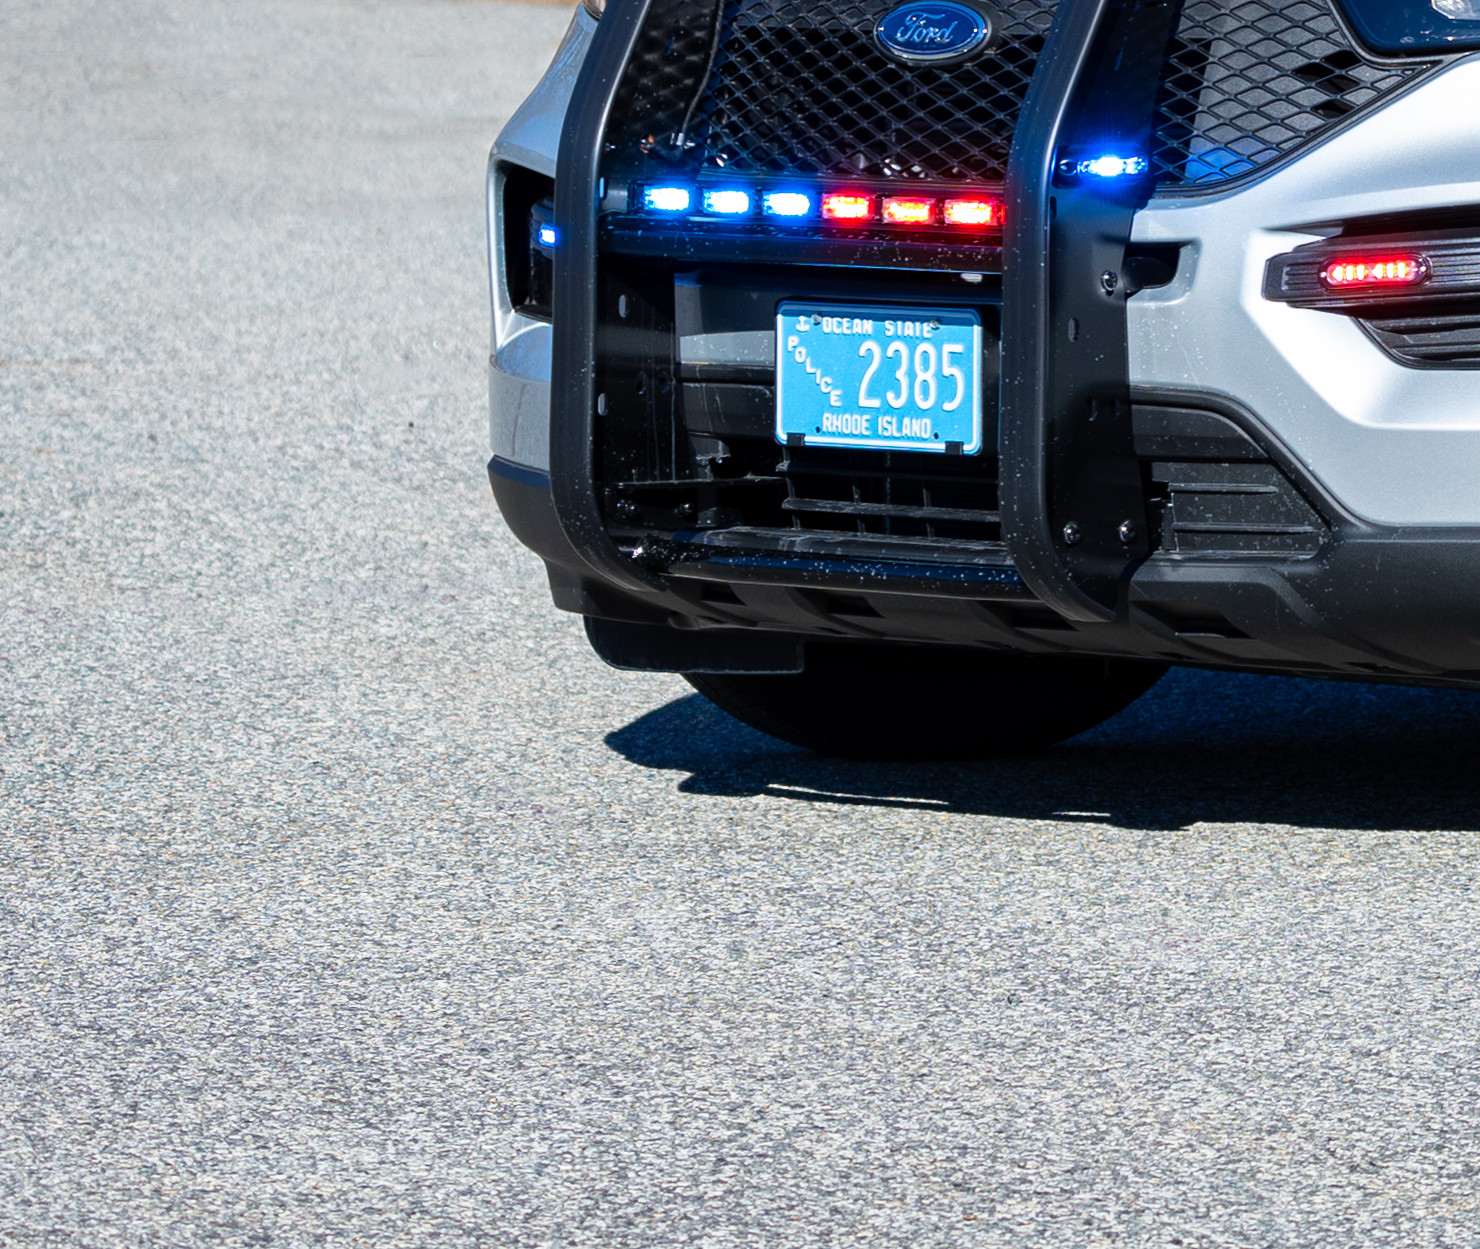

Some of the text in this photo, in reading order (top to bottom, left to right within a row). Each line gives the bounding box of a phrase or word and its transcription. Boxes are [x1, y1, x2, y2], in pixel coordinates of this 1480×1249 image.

[896, 12, 958, 44] Ford
[822, 316, 933, 339] OCEAN STATE
[787, 335, 843, 407] POLICE
[858, 340, 965, 412] 2385
[822, 413, 932, 440] RHODE ISLAND
